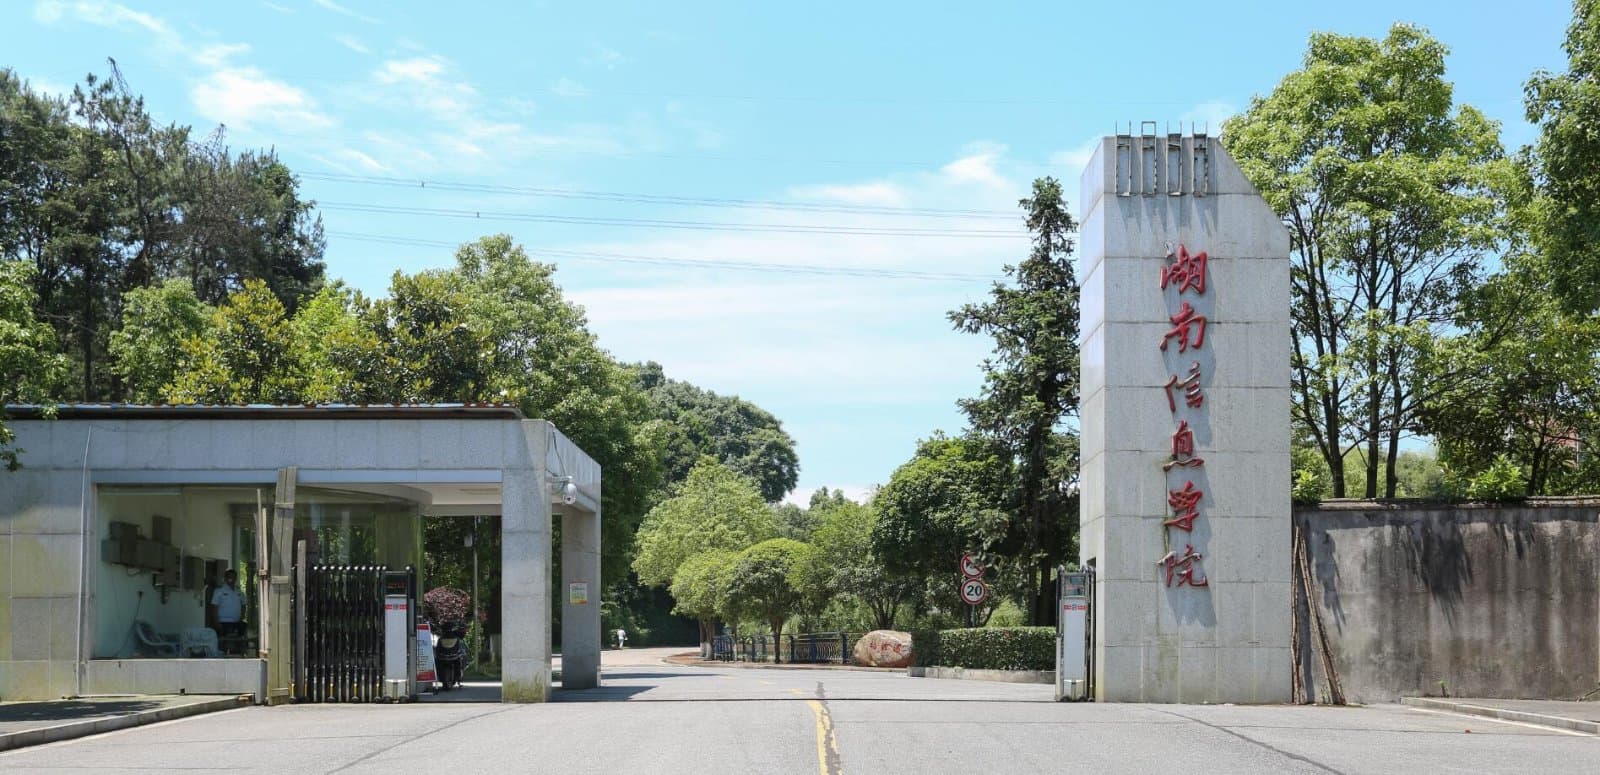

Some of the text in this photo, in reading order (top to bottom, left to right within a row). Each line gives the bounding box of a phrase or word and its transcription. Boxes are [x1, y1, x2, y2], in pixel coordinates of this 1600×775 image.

[1159, 242, 1209, 588] 湖南信息学院
[966, 585, 982, 597] 20
